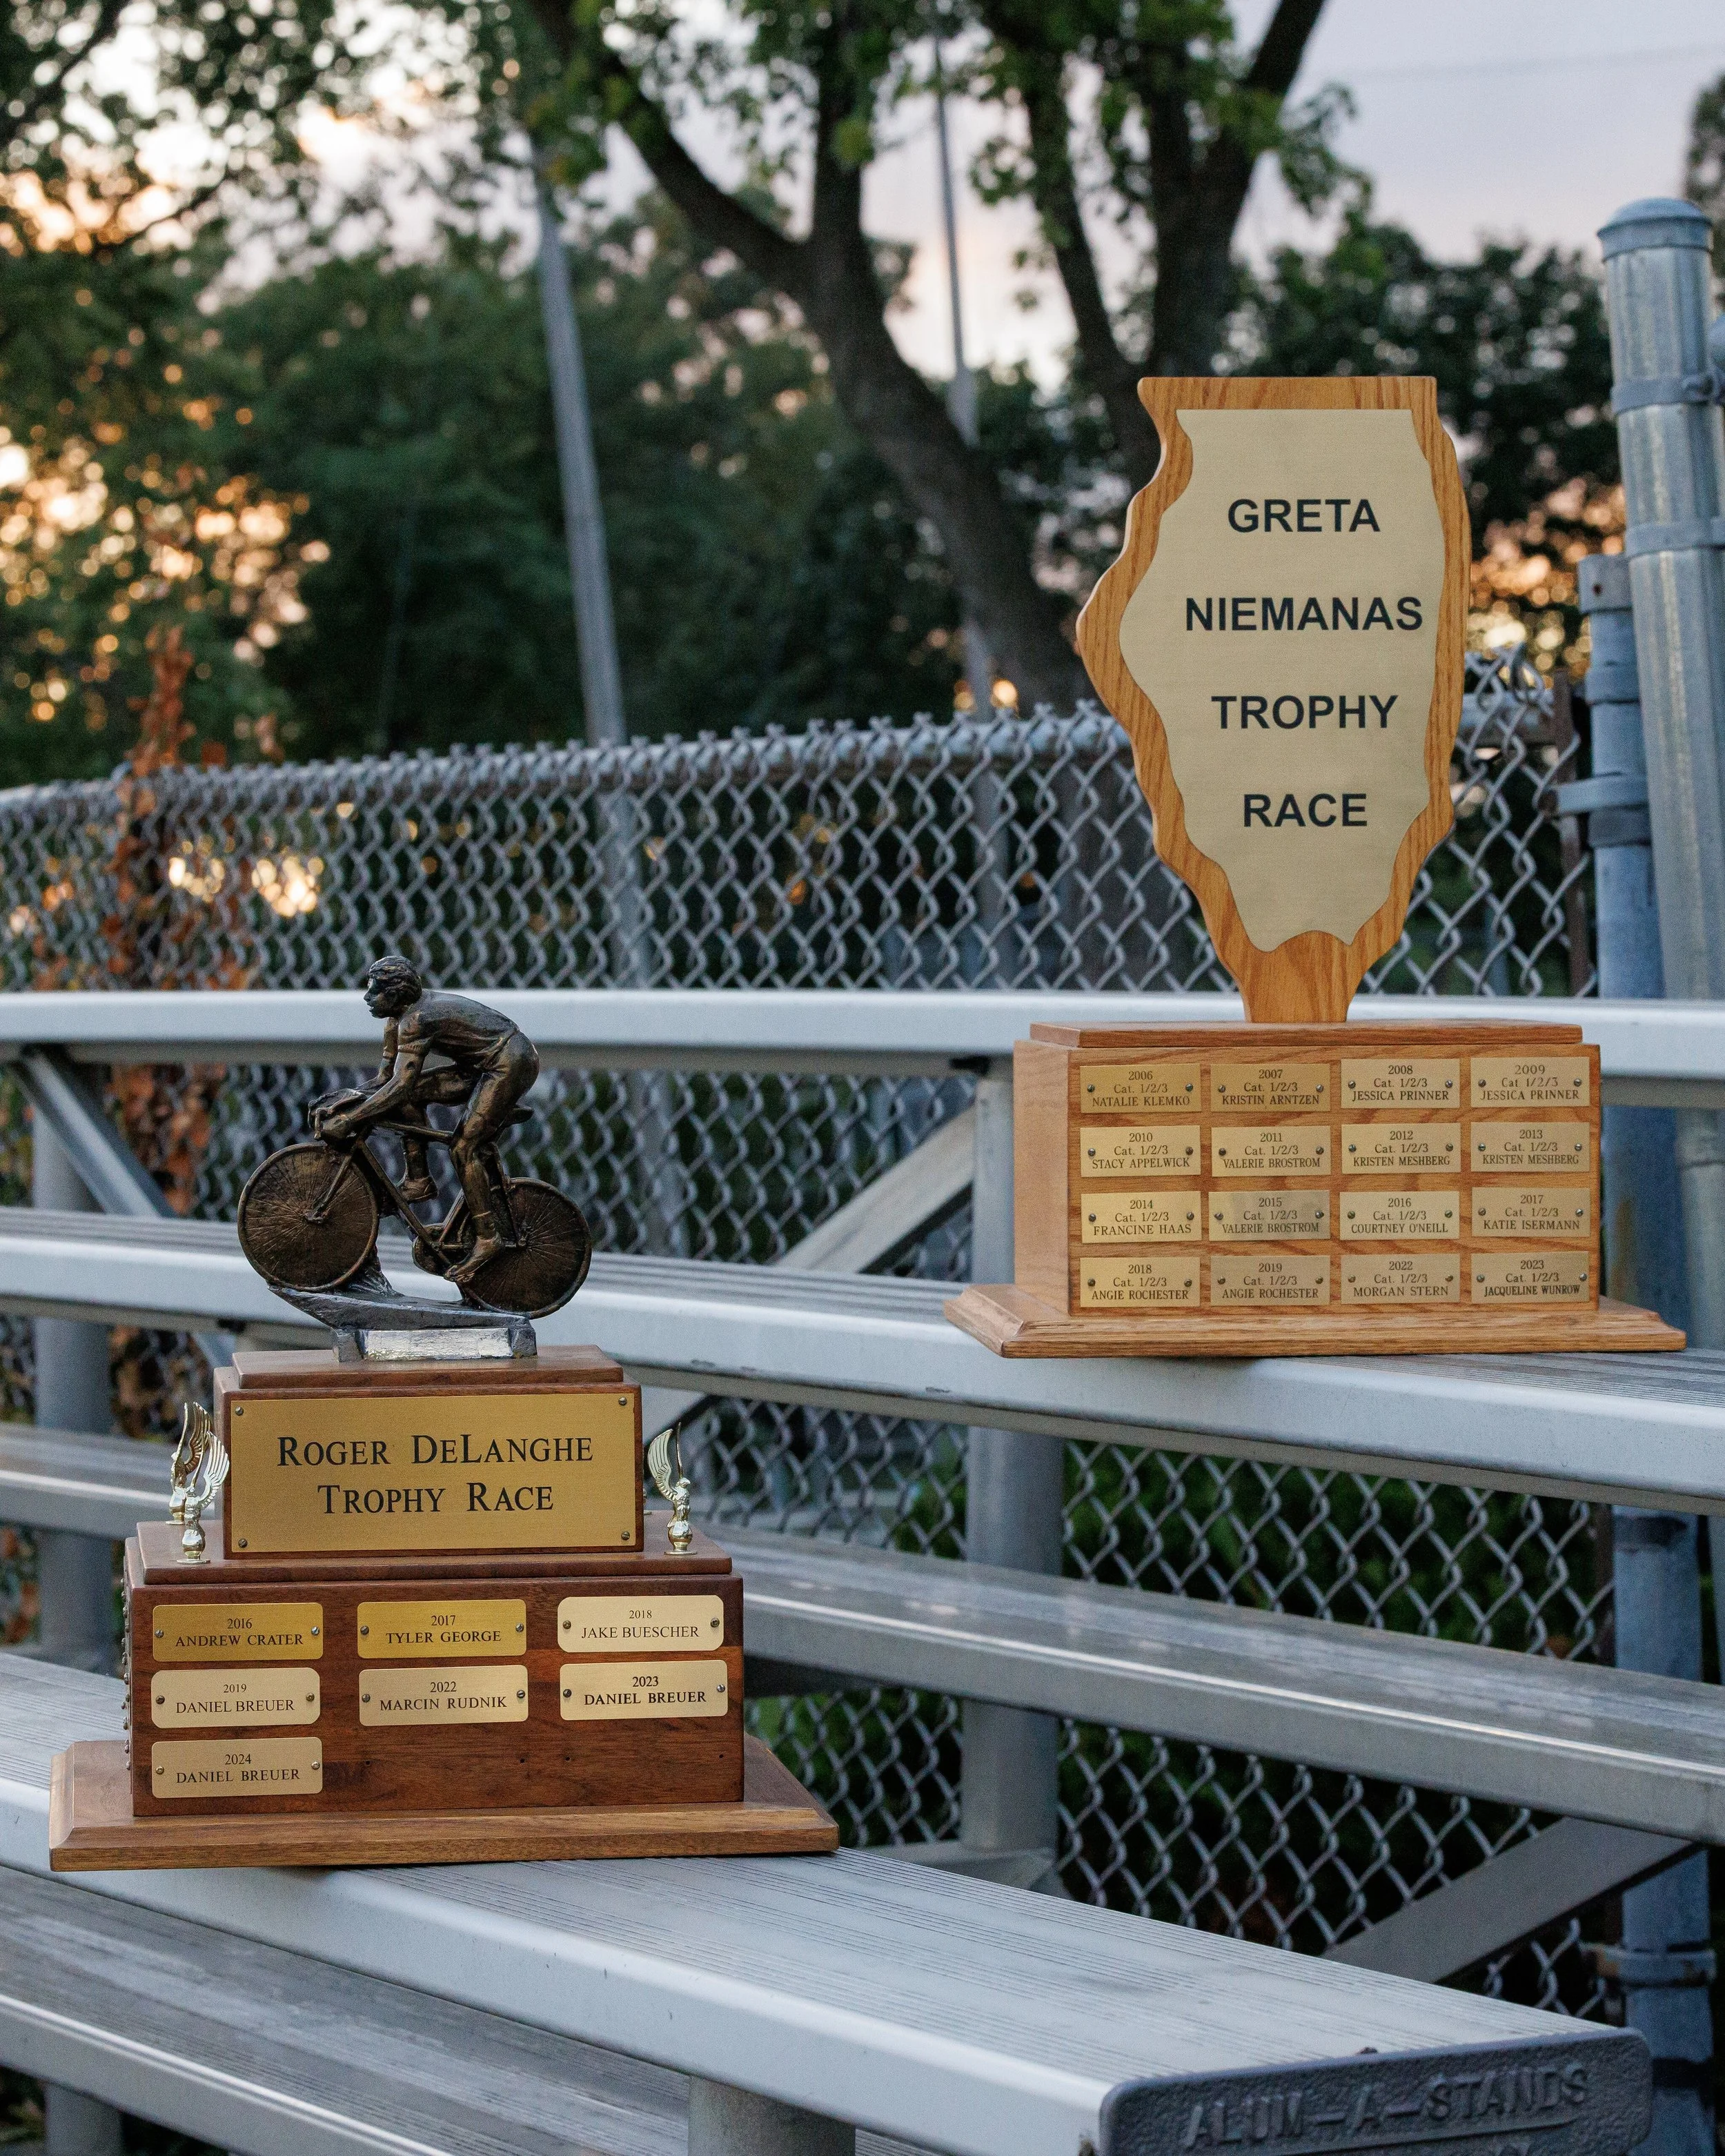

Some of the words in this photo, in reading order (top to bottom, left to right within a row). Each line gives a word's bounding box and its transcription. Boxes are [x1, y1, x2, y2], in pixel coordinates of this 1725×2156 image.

[1228, 499, 1381, 533] GRETA
[1185, 596, 1423, 631] NIEMANAS
[1211, 695, 1398, 729] TROPHY
[1243, 793, 1368, 827] RACE
[1259, 1069, 1283, 1079] 2007
[1388, 1065, 1413, 1074] 2008
[1515, 1065, 1546, 1074] 2009
[1128, 1071, 1153, 1080] 2006
[1244, 1082, 1264, 1091] Cat.
[1270, 1082, 1298, 1091] 1/2/3
[1374, 1078, 1394, 1087] Cat.
[1400, 1078, 1428, 1087] 1/2/3
[1526, 1077, 1558, 1087] 1/2/3
[1114, 1085, 1134, 1094] Cat.
[1140, 1083, 1168, 1094] 1/2/3
[1222, 1096, 1265, 1105] KRISTIN
[1270, 1095, 1319, 1105] ARNTZEN
[1352, 1091, 1394, 1101] JESSICA
[1400, 1091, 1448, 1100] PRINNER
[1480, 1091, 1525, 1101] JESSICA
[1530, 1090, 1579, 1100] PRINNER
[1092, 1097, 1138, 1107] NATALIE
[1143, 1096, 1190, 1106] KLEMKO
[1129, 1132, 1153, 1143] 2010
[1260, 1132, 1283, 1143] 2011
[1390, 1130, 1413, 1140] 2012
[1519, 1129, 1543, 1139] 2013
[1114, 1146, 1134, 1156] Cat.
[1141, 1145, 1168, 1155] 1/2/3
[1244, 1146, 1265, 1155] Cat.
[1271, 1145, 1299, 1155] 1/2/3
[1375, 1144, 1395, 1154] Cat.
[1401, 1143, 1428, 1153] 1/2/3
[1504, 1143, 1525, 1151] Cat.
[1530, 1142, 1558, 1151] 1/2/3
[1092, 1159, 1125, 1169] STACY
[1129, 1157, 1190, 1168] APPELWICK
[1223, 1158, 1264, 1168] VALERIE
[1268, 1157, 1321, 1167] BROSTROM
[1353, 1156, 1394, 1167] KRISTEN
[1399, 1156, 1450, 1165] MESHBERG
[1483, 1155, 1523, 1165] KRISTEN
[1528, 1154, 1579, 1165] MESHBERG
[1130, 1200, 1154, 1209] 2014
[1259, 1198, 1283, 1207] 2015
[1388, 1198, 1412, 1207] 2016
[1520, 1194, 1544, 1204] 2017
[1115, 1213, 1136, 1223] Cat.
[1141, 1212, 1169, 1222] 1/2/3
[1243, 1211, 1264, 1220] Cat.
[1270, 1210, 1297, 1220] 1/2/3
[1373, 1211, 1393, 1220] Cat.
[1399, 1210, 1426, 1220] 1/2/3
[1505, 1208, 1526, 1217] Cat.
[1531, 1207, 1559, 1217] 1/2/3
[1094, 1225, 1154, 1236] FRANCINE
[1159, 1224, 1192, 1234] HAAS
[1222, 1224, 1263, 1234] VALERIE
[1268, 1223, 1319, 1233] BROSTROM
[1351, 1224, 1405, 1234] COURTNEY
[1409, 1223, 1448, 1233] O'NEILL
[1483, 1220, 1517, 1230] KATIE
[1521, 1220, 1580, 1229] ISERMANN
[1127, 1264, 1152, 1274] 2018
[1259, 1263, 1282, 1272] 2019
[1389, 1260, 1413, 1271] 2022
[1520, 1260, 1544, 1269] 2023
[1113, 1278, 1134, 1287] Cat.
[1140, 1276, 1167, 1287] 1/2/3
[1243, 1276, 1264, 1285] Cat.
[1270, 1275, 1298, 1285] 1/2/3
[1374, 1274, 1394, 1283] Cat.
[1401, 1273, 1428, 1283] 1/2/3
[1506, 1273, 1526, 1283] Cat.
[1532, 1272, 1559, 1283] 1/2/3
[1092, 1290, 1125, 1300] ANGIE
[1129, 1289, 1189, 1300] ROCHESTER
[1222, 1289, 1254, 1298] ANGIE
[1259, 1288, 1319, 1298] ROCHESTER
[1353, 1287, 1406, 1296] MORGAN
[1410, 1286, 1449, 1296] STERN
[1483, 1286, 1538, 1297] JACQUELINE
[1541, 1285, 1581, 1295] WUNROW
[431, 1615, 456, 1625] 2017
[629, 1610, 652, 1619] 2018
[227, 1618, 253, 1629] 2016
[386, 1632, 433, 1643] TYLER
[440, 1631, 501, 1643] GEORGE
[581, 1627, 618, 1639] JAKE
[622, 1626, 699, 1639] BUESCHER
[175, 1634, 241, 1647] ANDREW
[247, 1634, 304, 1645] CRATER
[430, 1681, 457, 1693] 2022
[632, 1676, 659, 1688] 2023
[224, 1683, 247, 1694] 2019
[584, 1693, 641, 1705] DANIEL
[648, 1691, 707, 1703] BREUER
[176, 1701, 232, 1714] DANIEL
[235, 1699, 295, 1712] BREUER
[380, 1698, 439, 1711] MARCIN
[448, 1697, 507, 1709] RUDNIK
[225, 1754, 251, 1765] 2024
[176, 1770, 233, 1783] DANIEL
[241, 1769, 300, 1781] BREUER
